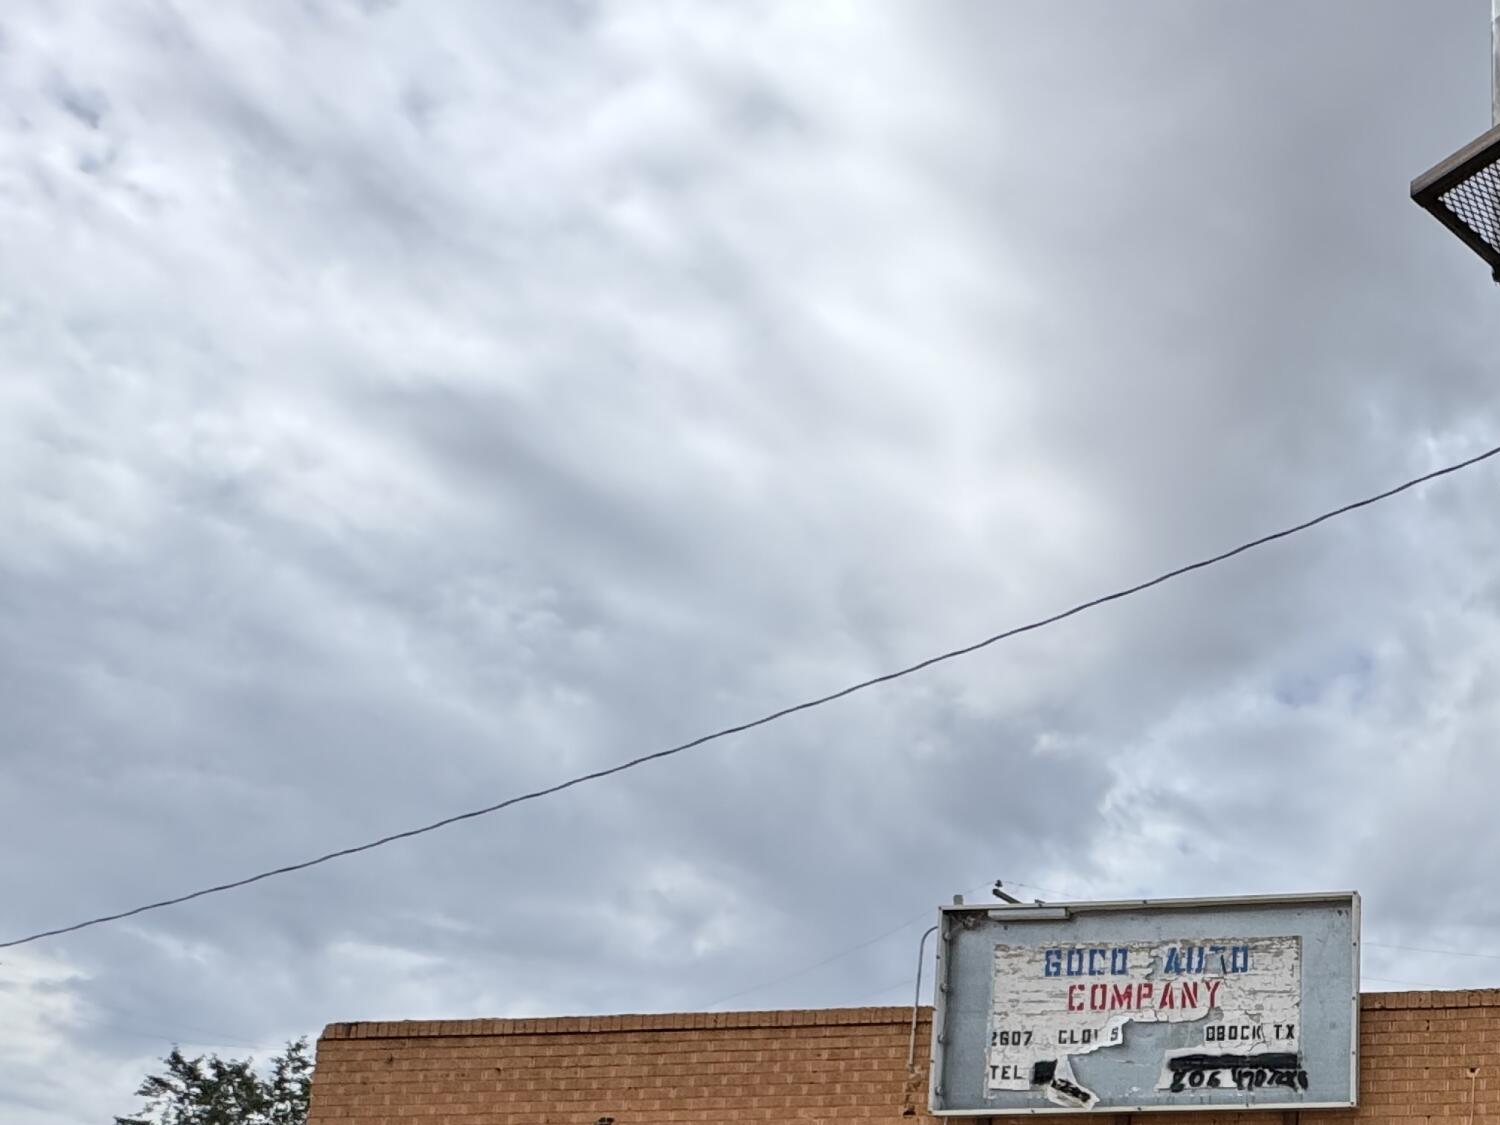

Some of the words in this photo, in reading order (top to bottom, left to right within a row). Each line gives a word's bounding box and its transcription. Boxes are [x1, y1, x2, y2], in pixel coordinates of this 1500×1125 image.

[1067, 980, 1221, 1012] COMPANY
[1274, 1024, 1295, 1040] TX
[990, 1065, 1025, 1080] TEL
